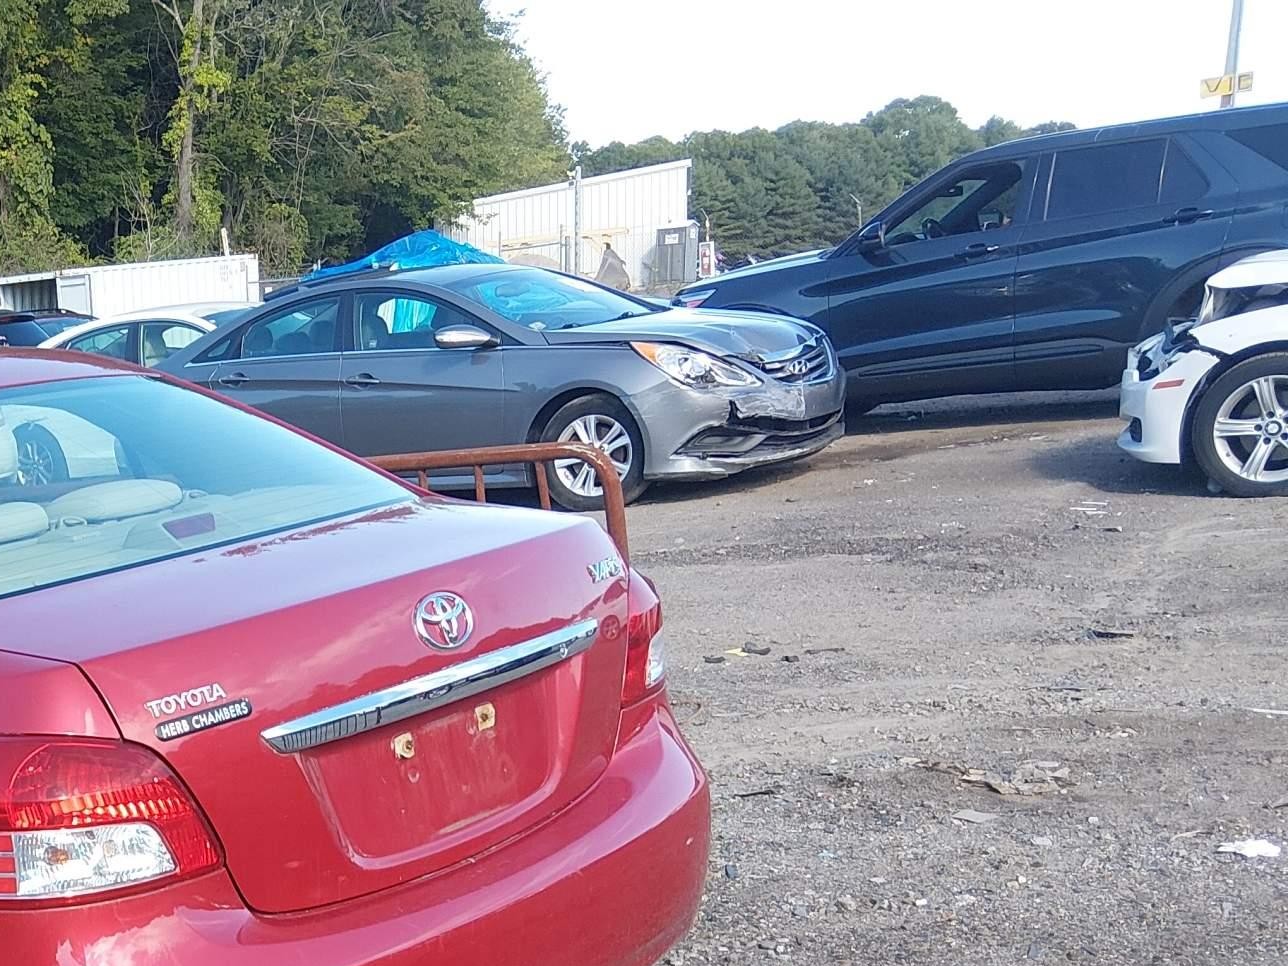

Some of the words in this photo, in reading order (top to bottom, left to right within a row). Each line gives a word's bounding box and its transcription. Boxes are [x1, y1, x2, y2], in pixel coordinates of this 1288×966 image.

[144, 683, 226, 718] TOYOTA
[160, 718, 190, 738] HERB
[192, 701, 249, 729] CHAMBERS
